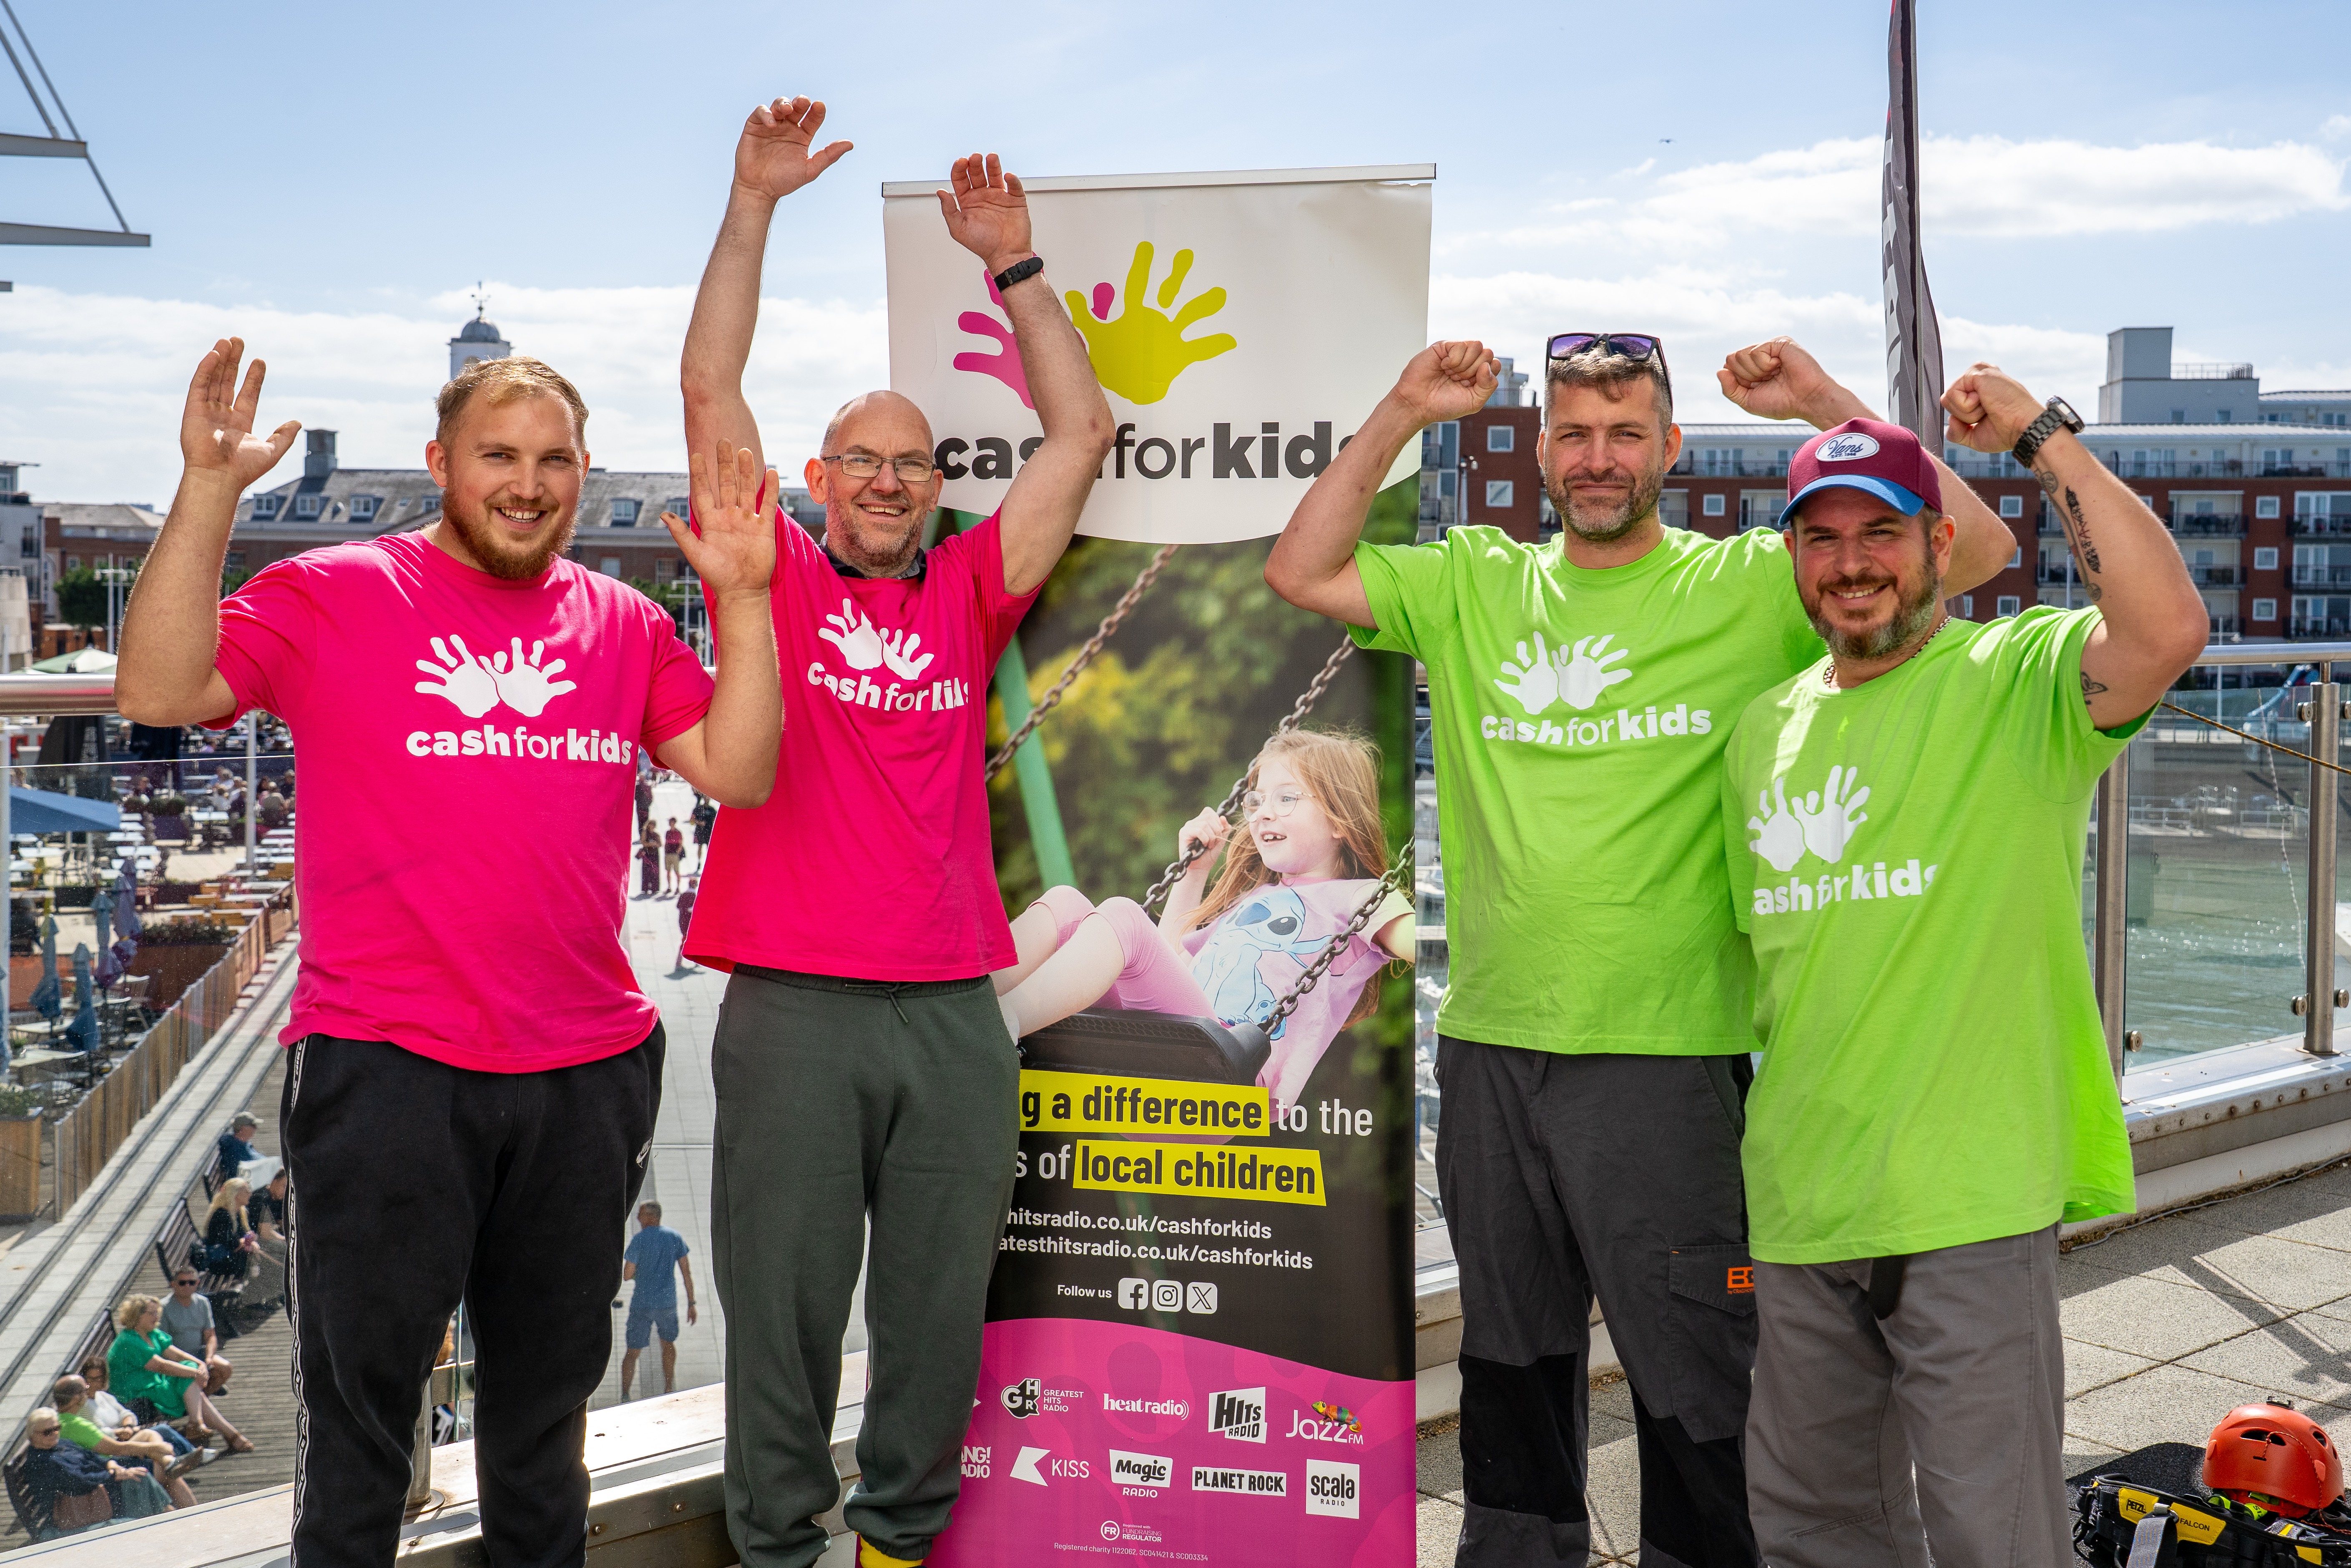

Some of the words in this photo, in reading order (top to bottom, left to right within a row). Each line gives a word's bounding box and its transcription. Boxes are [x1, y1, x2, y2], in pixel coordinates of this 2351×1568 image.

[1828, 437, 1863, 456] Vans
[1481, 704, 1711, 746] cashforkids
[406, 724, 633, 765] cashforkids
[1052, 1091, 1071, 1120] a
[1083, 1085, 1262, 1129] difference
[1276, 1098, 1307, 1133] to
[1319, 1099, 1373, 1136] the
[1039, 1145, 1070, 1179] of
[1081, 1145, 1163, 1185] local
[1174, 1152, 1315, 1194] children
[1007, 1207, 1271, 1239] hitsradio.co.uk/cashforkids
[999, 1235, 1312, 1269] atesthitsradio.co.uk/cashforkids
[1057, 1285, 1095, 1298] Follow
[1098, 1288, 1112, 1299] us
[1044, 1389, 1084, 1398] GREATEST
[1228, 1423, 1260, 1438] RADIO
[1286, 1410, 1347, 1443] Jazz
[1349, 1434, 1363, 1445] FM
[961, 1446, 991, 1464] NG!
[1052, 1459, 1090, 1478] KISS
[1115, 1459, 1166, 1482] Magic
[1195, 1471, 1244, 1490] PLANET
[1248, 1475, 1284, 1493] ROCK
[1311, 1473, 1355, 1500] scala
[1123, 1487, 1158, 1498] RADIO
[2126, 1498, 2147, 1514] PETZL
[1104, 1527, 1117, 1535] FR
[1123, 1528, 1162, 1536] FUNDRAISING
[2180, 1518, 2210, 1531] FALCON
[1123, 1534, 1162, 1542] REGULATOR
[1054, 1542, 1088, 1551] Registered
[1112, 1547, 1138, 1555] 1122062,
[1139, 1549, 1168, 1558] SC041421
[1176, 1553, 1208, 1561] SC003334
